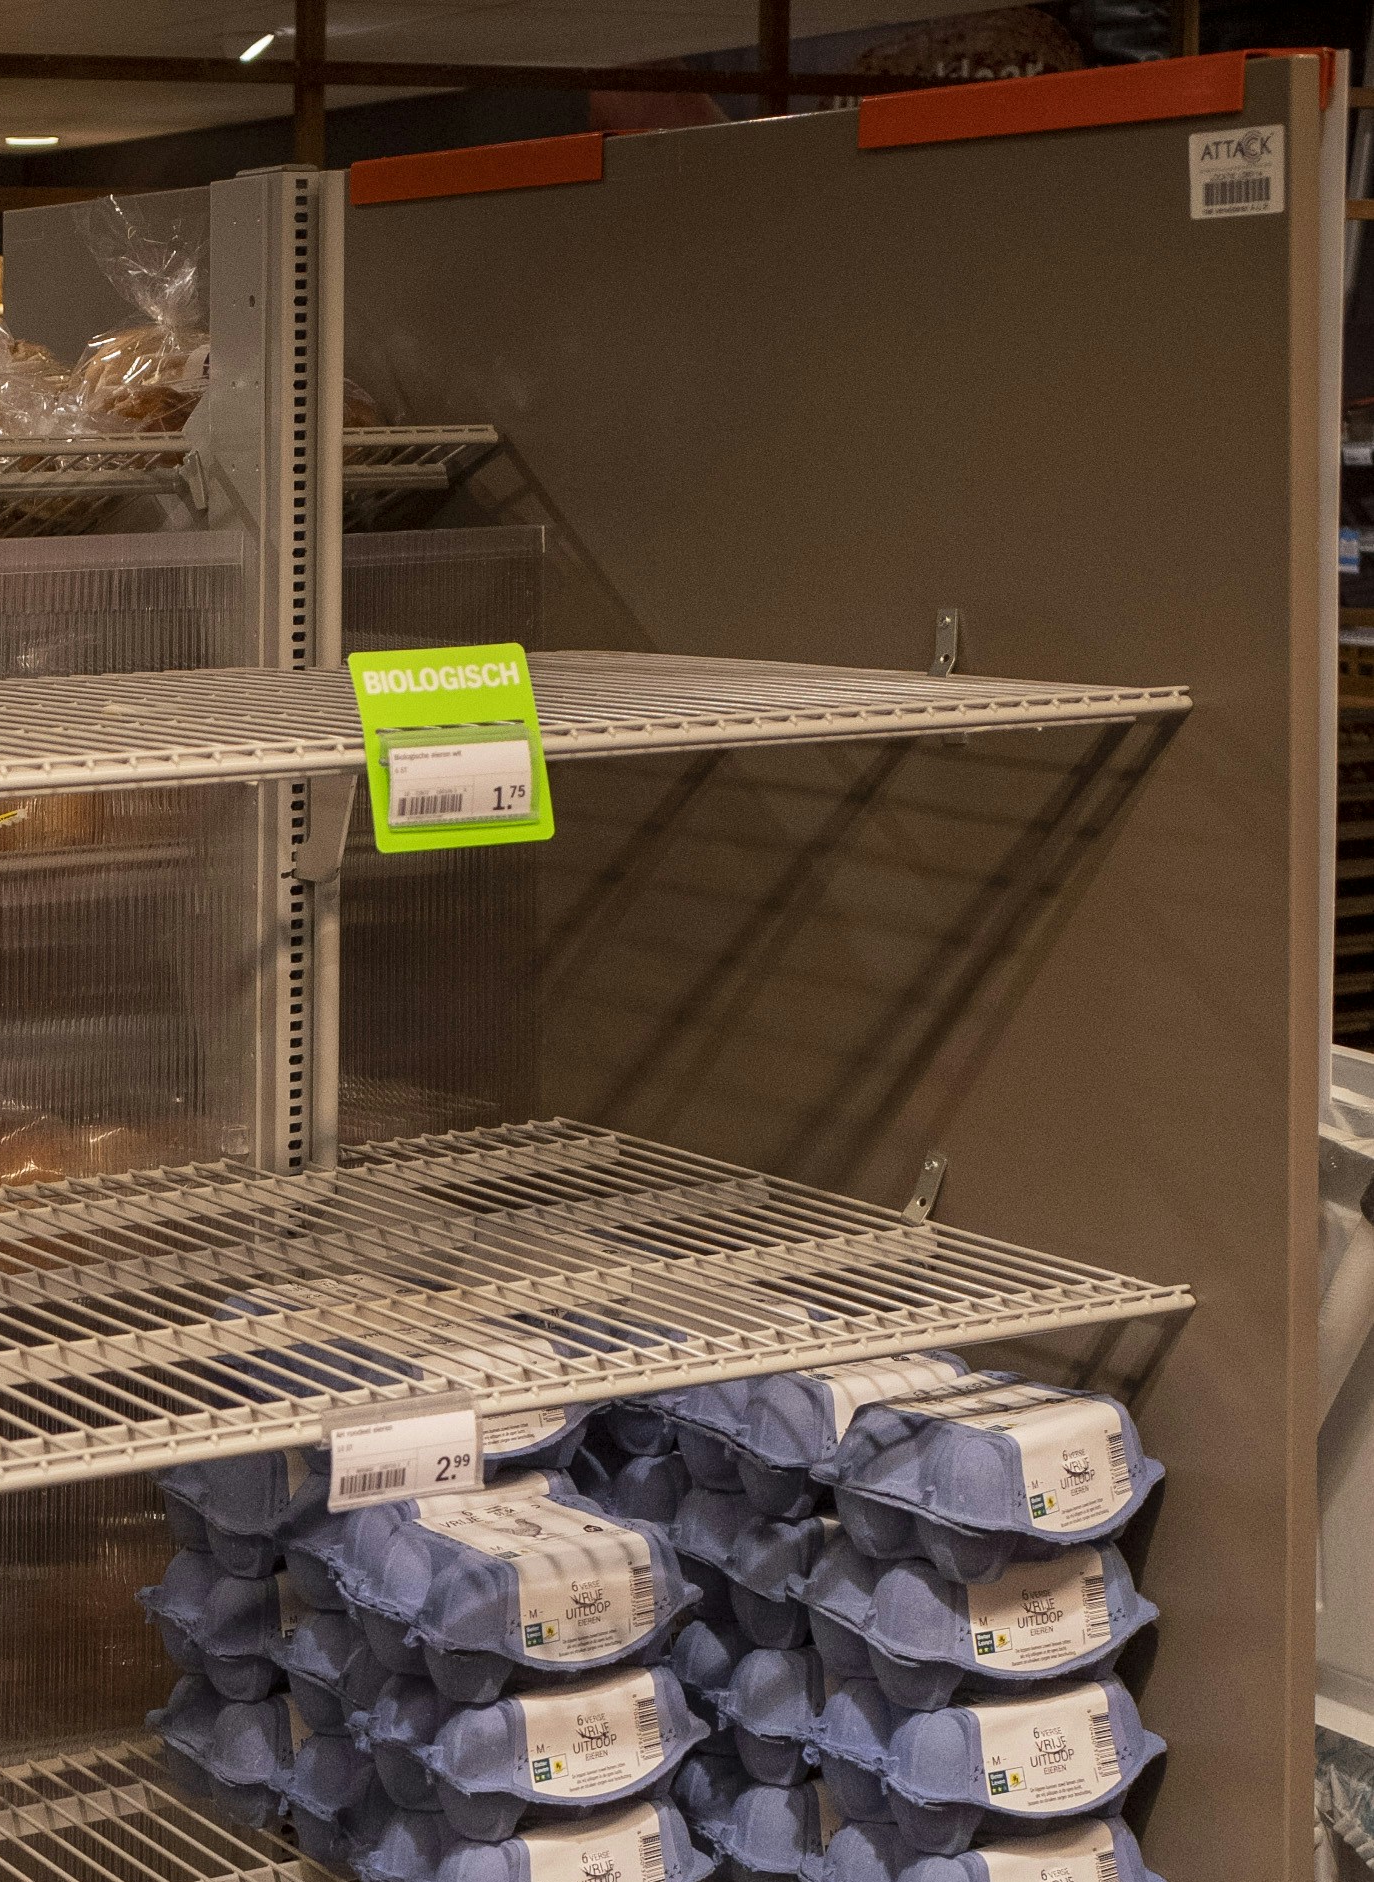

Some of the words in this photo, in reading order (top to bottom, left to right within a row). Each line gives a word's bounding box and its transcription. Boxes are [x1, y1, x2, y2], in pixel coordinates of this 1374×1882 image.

[1201, 135, 1272, 162] ATTACK
[362, 661, 520, 695] BIOLOGISCH
[394, 751, 429, 761] Biologische
[492, 784, 526, 811] 1.75
[435, 1454, 470, 1482] 2.99
[1063, 1457, 1089, 1472] VRIJE
[1060, 1470, 1096, 1491] UITLOOP
[439, 1515, 484, 1529] VRIJE
[571, 1588, 604, 1603] VRIJE
[566, 1601, 611, 1621] UITLOOP
[1023, 1598, 1055, 1613] VRIJE
[578, 1616, 601, 1627] EIEREN
[1017, 1610, 1064, 1629] UITLOOP
[579, 1722, 610, 1738] VRIJE
[572, 1734, 617, 1754] UITLOOP
[1035, 1736, 1067, 1751] VRIJE
[585, 1750, 609, 1762] EIEREN
[1030, 1749, 1075, 1768] UITLOOP
[584, 1860, 615, 1875] VRIJE
